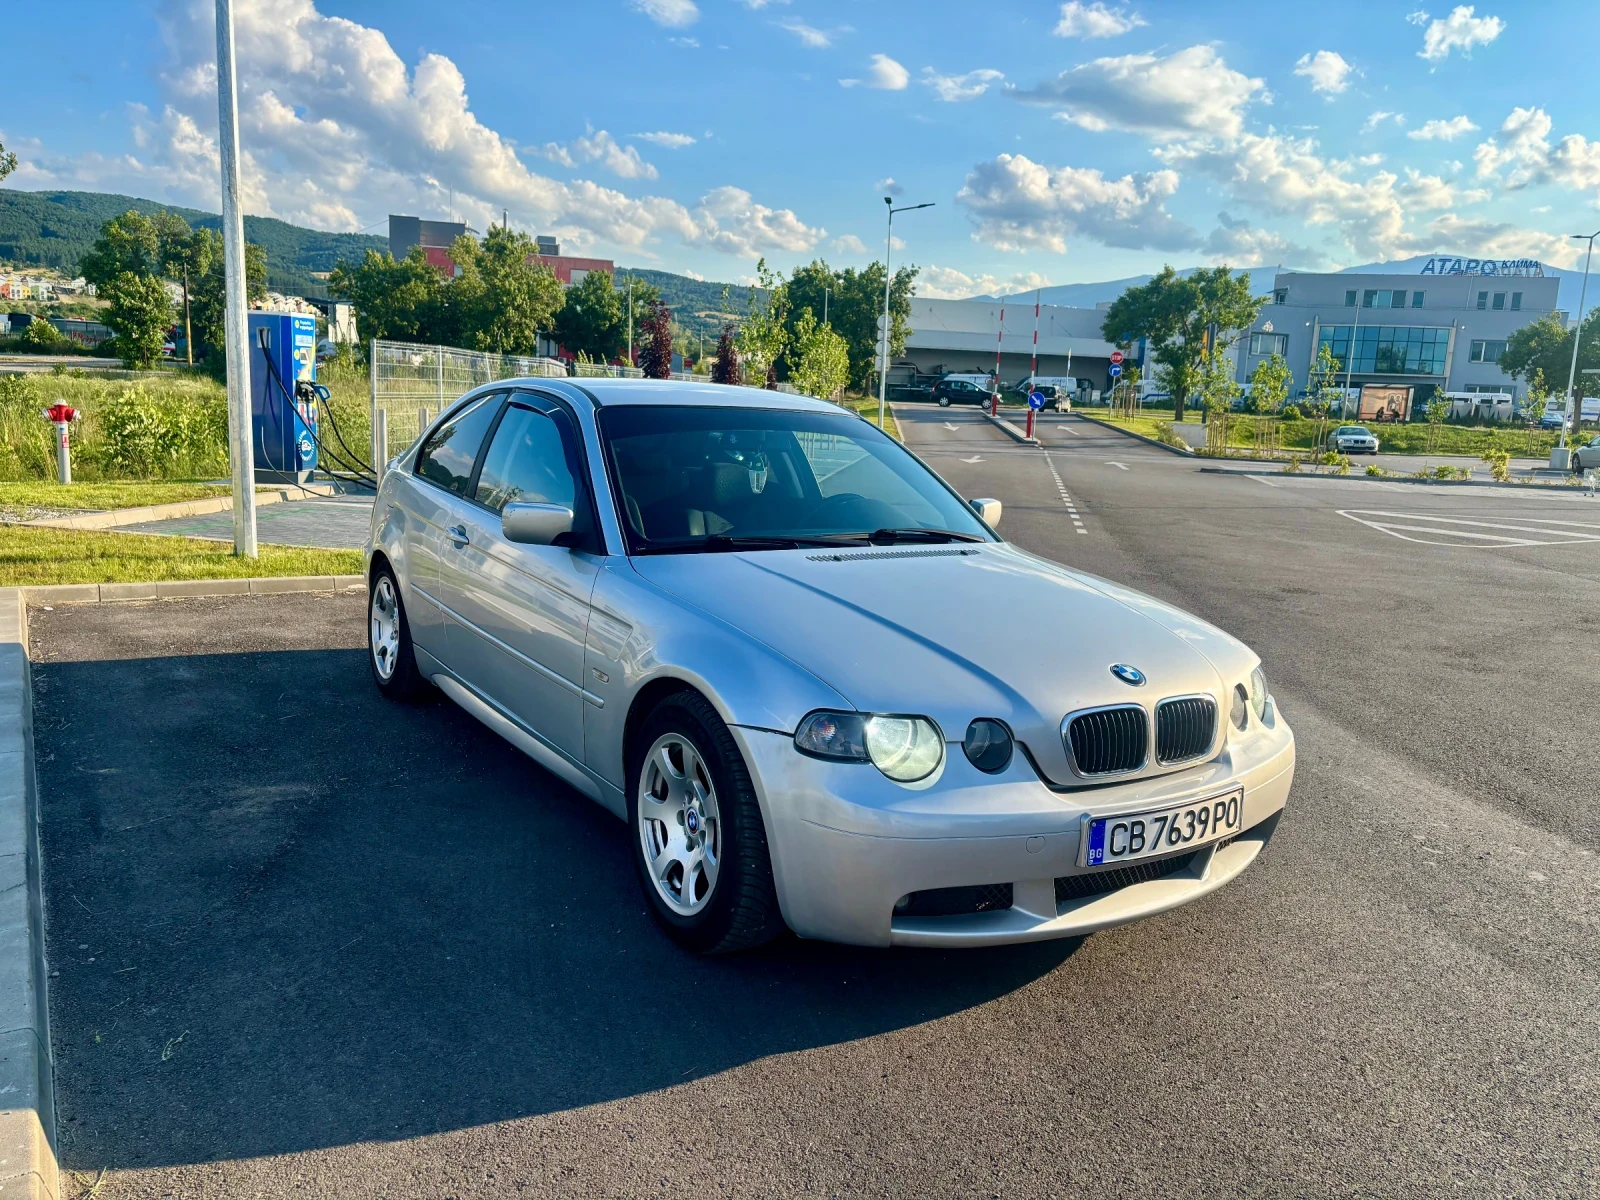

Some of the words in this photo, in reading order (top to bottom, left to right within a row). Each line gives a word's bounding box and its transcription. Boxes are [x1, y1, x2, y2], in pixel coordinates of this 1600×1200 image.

[1501, 259, 1539, 269] КЛИМА
[1110, 820, 1146, 857] CB
[1149, 806, 1210, 852] 7639
[1089, 848, 1103, 860] BG
